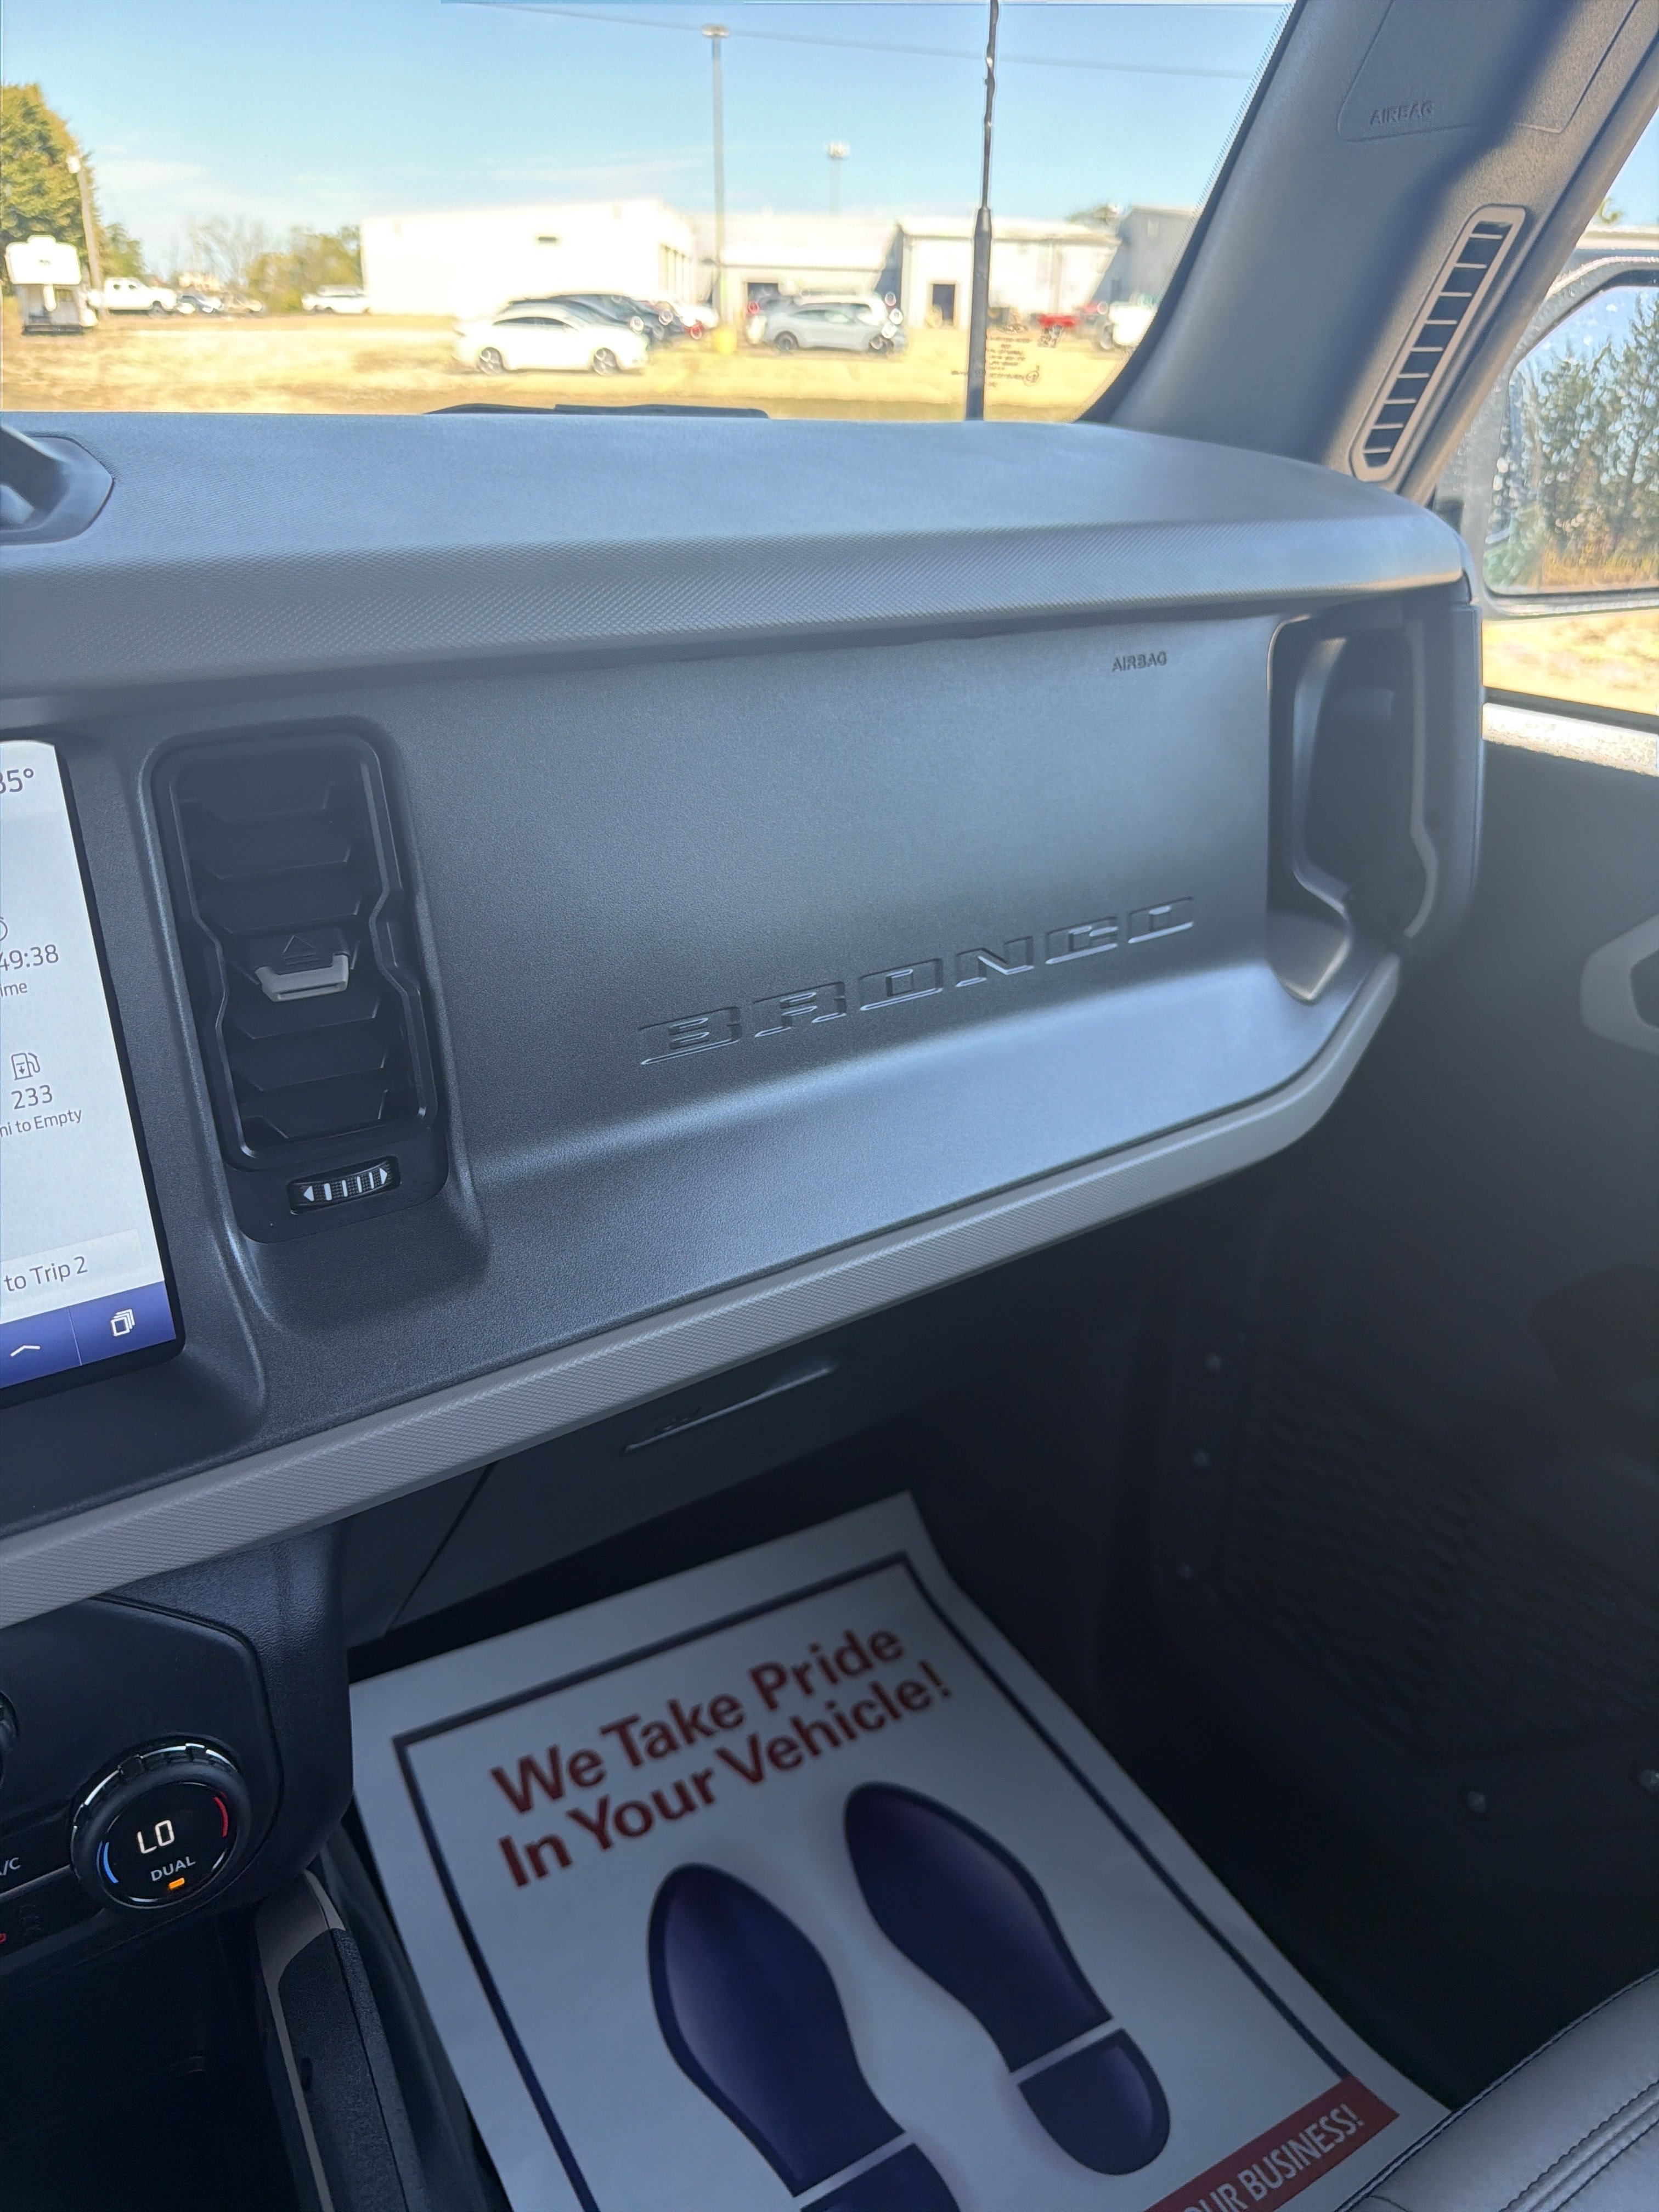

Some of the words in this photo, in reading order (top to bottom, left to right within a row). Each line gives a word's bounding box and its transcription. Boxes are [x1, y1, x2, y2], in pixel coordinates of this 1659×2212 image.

[1370, 100, 1433, 126] AIRBAG
[1111, 651, 1167, 672] AIRBAG
[638, 896, 1194, 1064] BRONCO
[11, 1085, 53, 1109] 233
[15, 1120, 31, 1133] to
[33, 1110, 82, 1130] Empty
[3, 1274, 26, 1291] to
[29, 1263, 71, 1284] Trip
[74, 1256, 88, 1274] 2
[490, 1745, 607, 1815] We
[600, 1699, 745, 1768] Take
[749, 1628, 905, 1711] Pride
[498, 1833, 573, 1888] In
[567, 1768, 715, 1851] Your
[715, 1660, 951, 1784] Vehicle!
[137, 1820, 175, 1854] LO
[151, 1856, 196, 1882] DUAL
[1237, 2104, 1365, 2202] BUSINESS!
